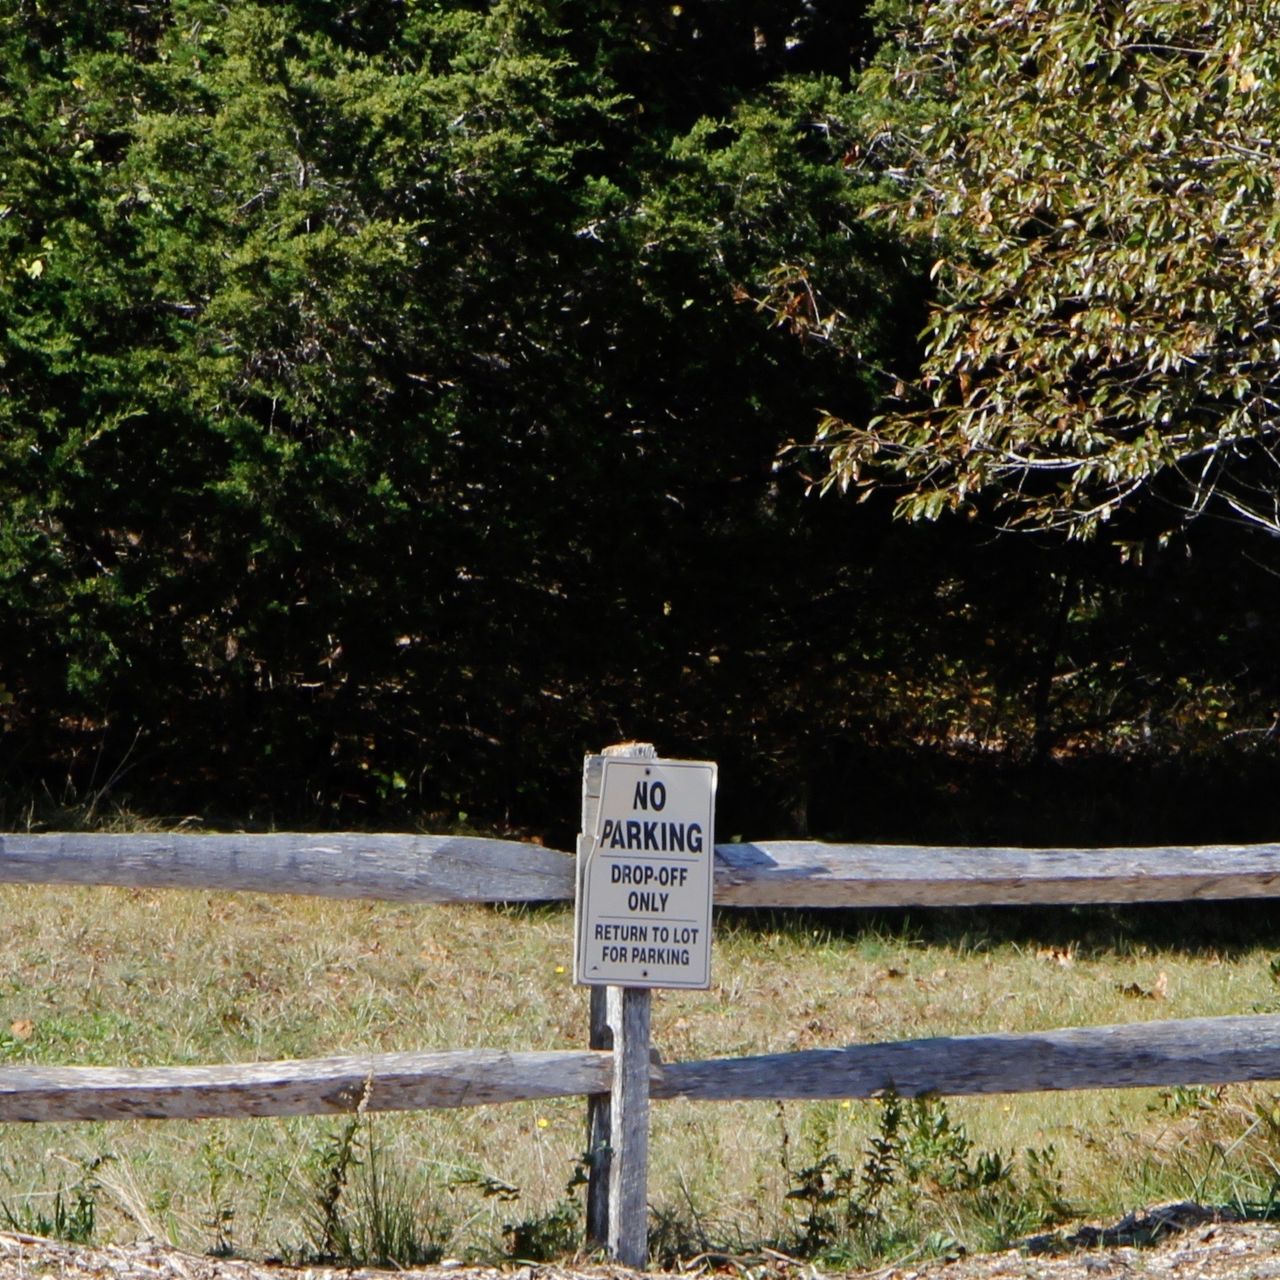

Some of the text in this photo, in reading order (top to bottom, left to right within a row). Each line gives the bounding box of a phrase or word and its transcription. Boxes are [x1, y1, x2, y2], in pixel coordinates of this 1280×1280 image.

[633, 781, 666, 811] NO
[600, 820, 702, 853] PARKING
[611, 864, 688, 887] DROP-OFF
[628, 891, 669, 912] ONLY
[595, 924, 699, 944] RETURN TO LOT
[602, 946, 689, 965] FOR PARKING
